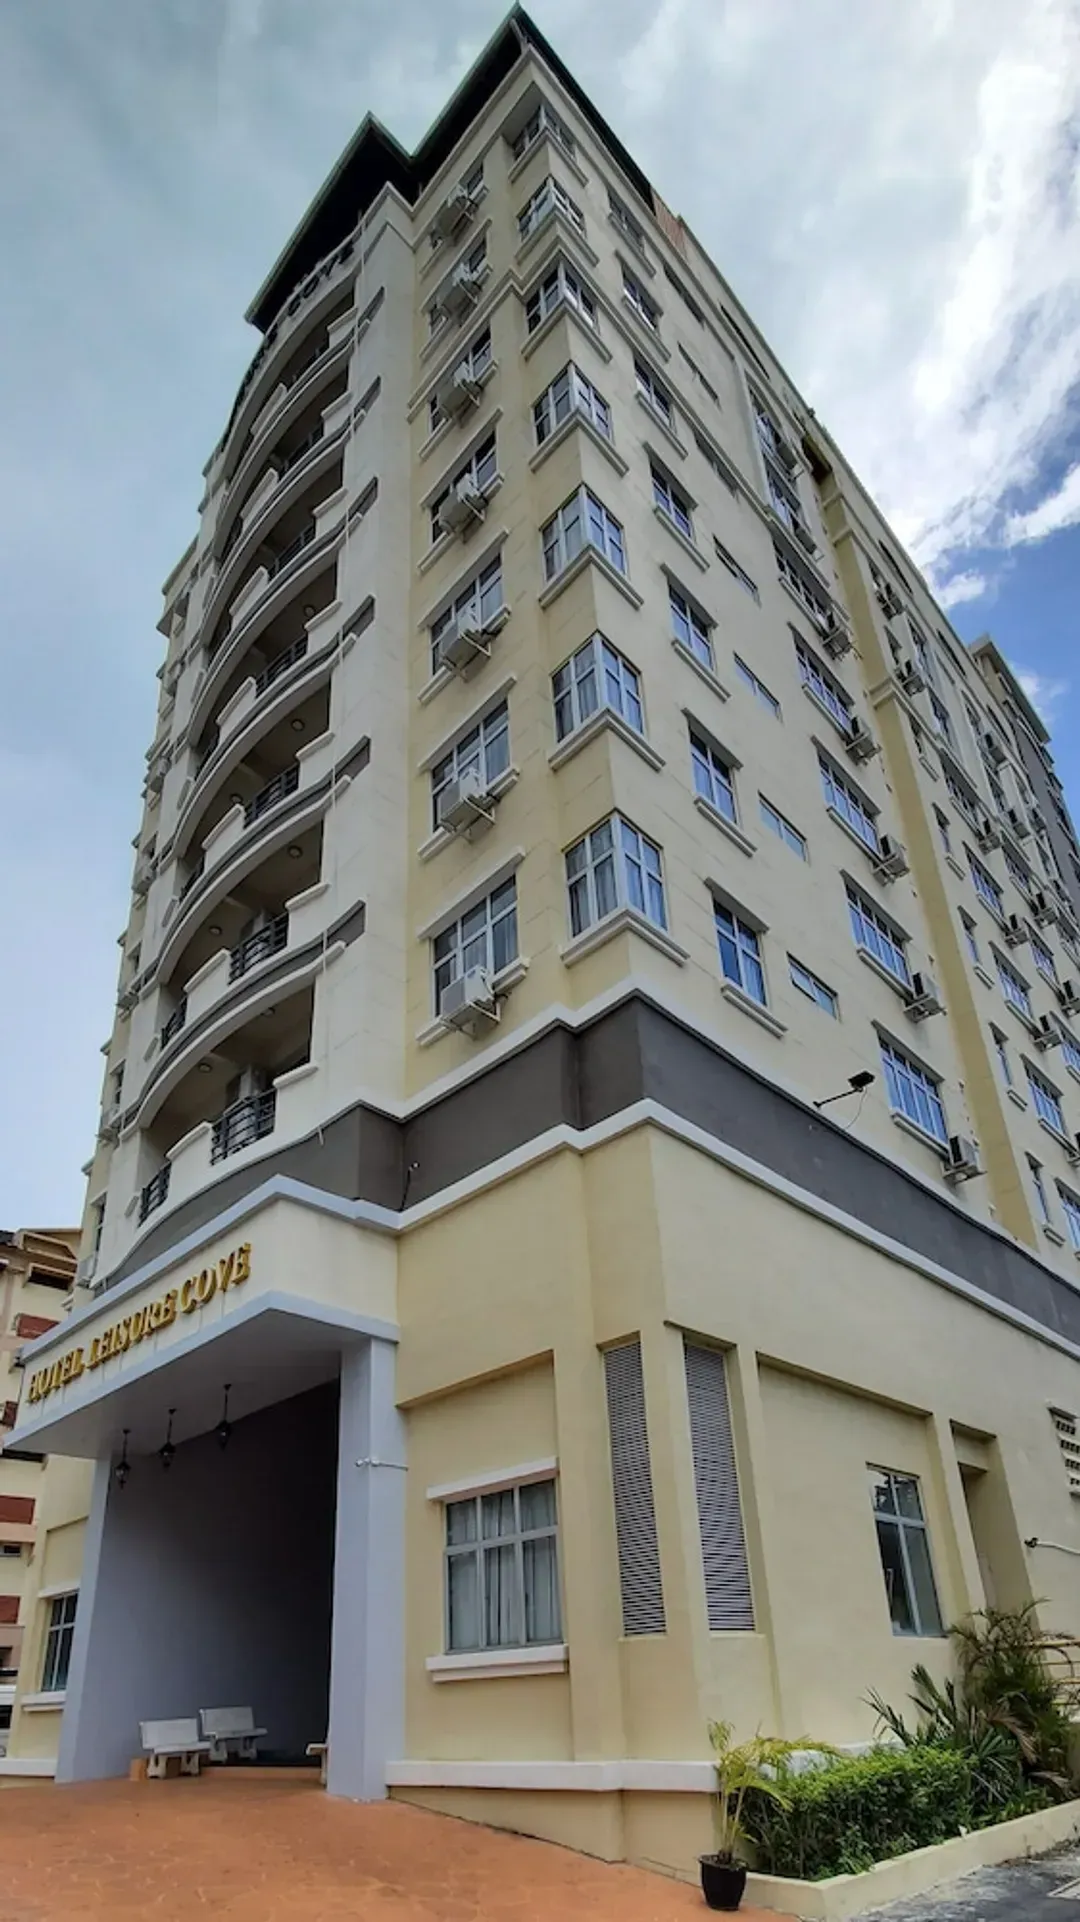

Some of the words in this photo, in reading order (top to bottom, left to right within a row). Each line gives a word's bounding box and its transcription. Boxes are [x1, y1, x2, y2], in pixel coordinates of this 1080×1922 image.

[28, 1347, 86, 1403] HOTEL
[87, 1289, 179, 1370] LEISURE
[180, 1243, 251, 1314] COVE
